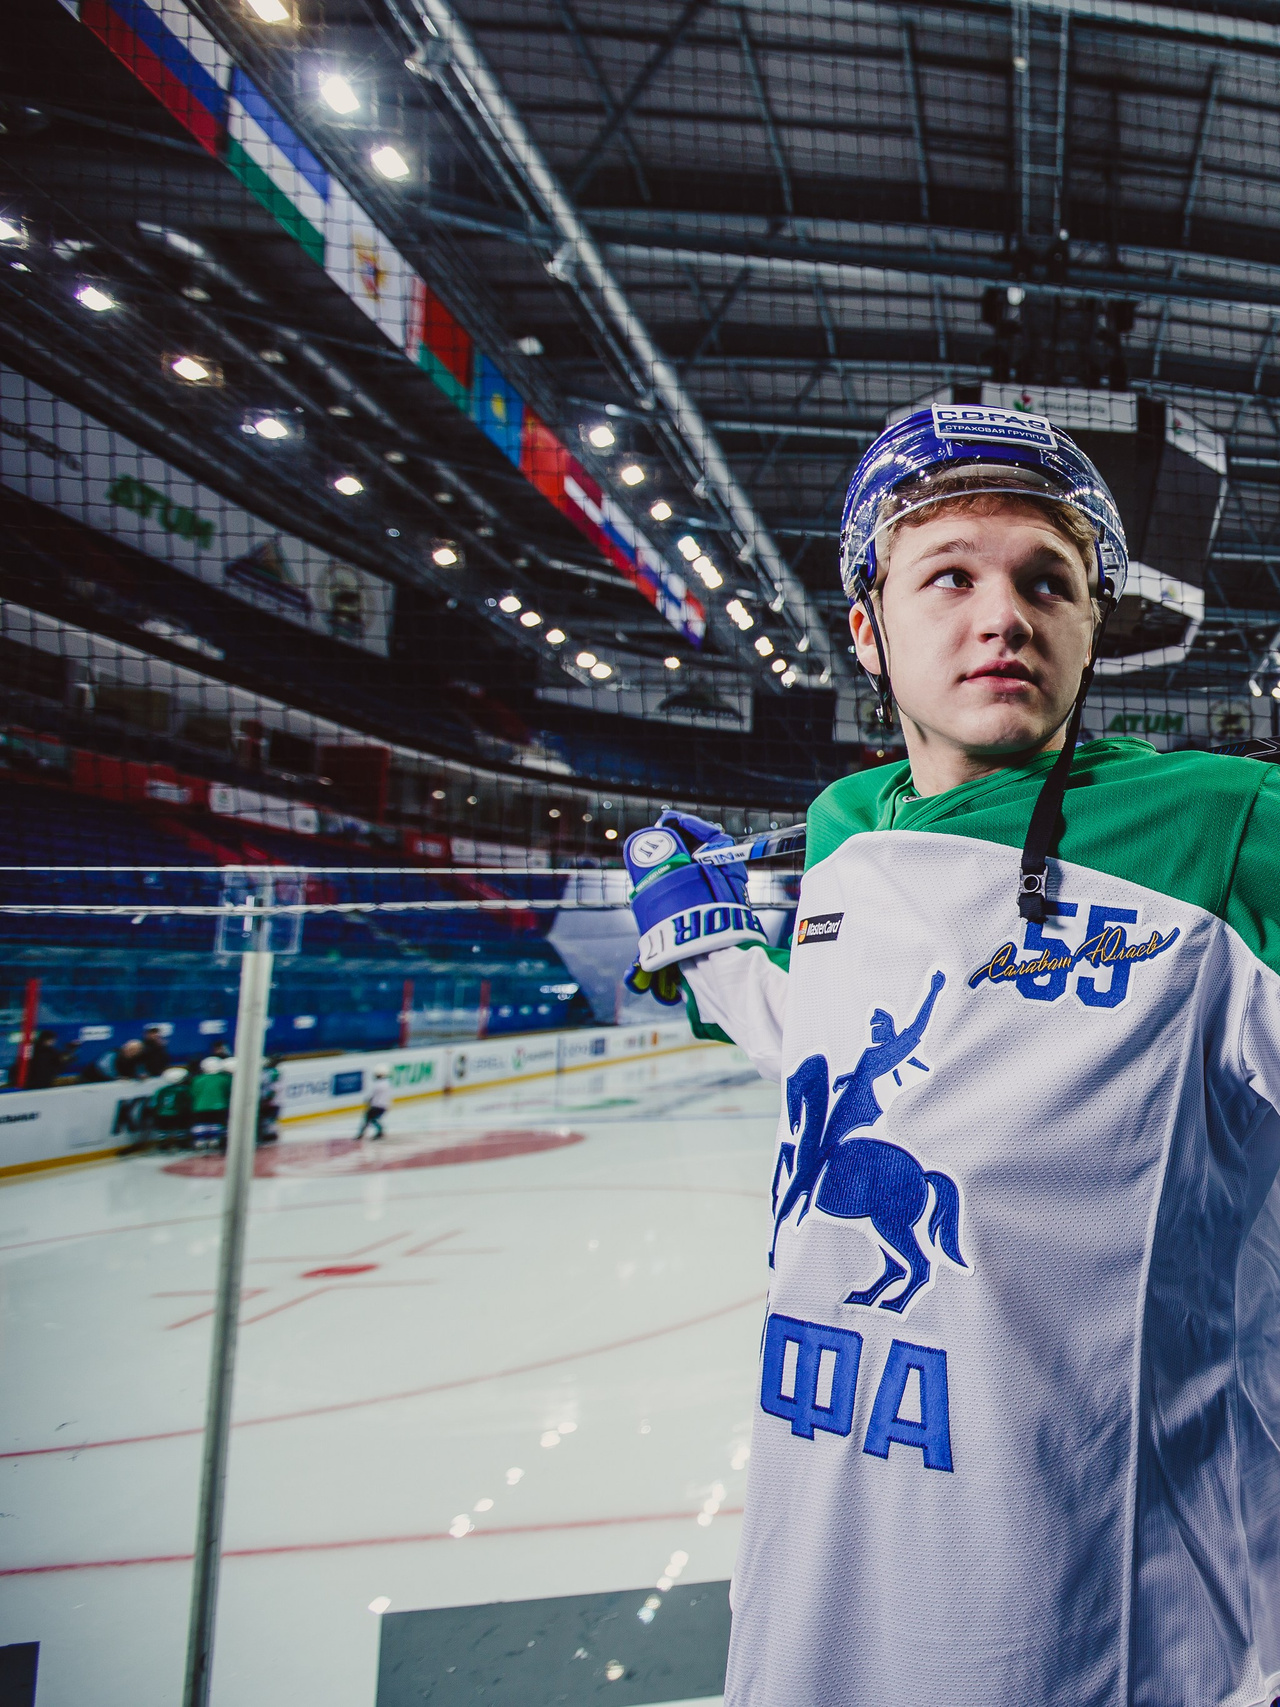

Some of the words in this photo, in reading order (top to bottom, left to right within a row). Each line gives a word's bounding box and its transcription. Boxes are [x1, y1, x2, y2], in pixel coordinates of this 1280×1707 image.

[945, 424, 1006, 434] СТРАХОВАЯ
[1007, 429, 1047, 442] ГРУППА
[1107, 713, 1185, 733] ATUM
[671, 907, 769, 946] RIOR
[806, 919, 841, 936] MasterCard
[761, 1312, 954, 1473] ФА
